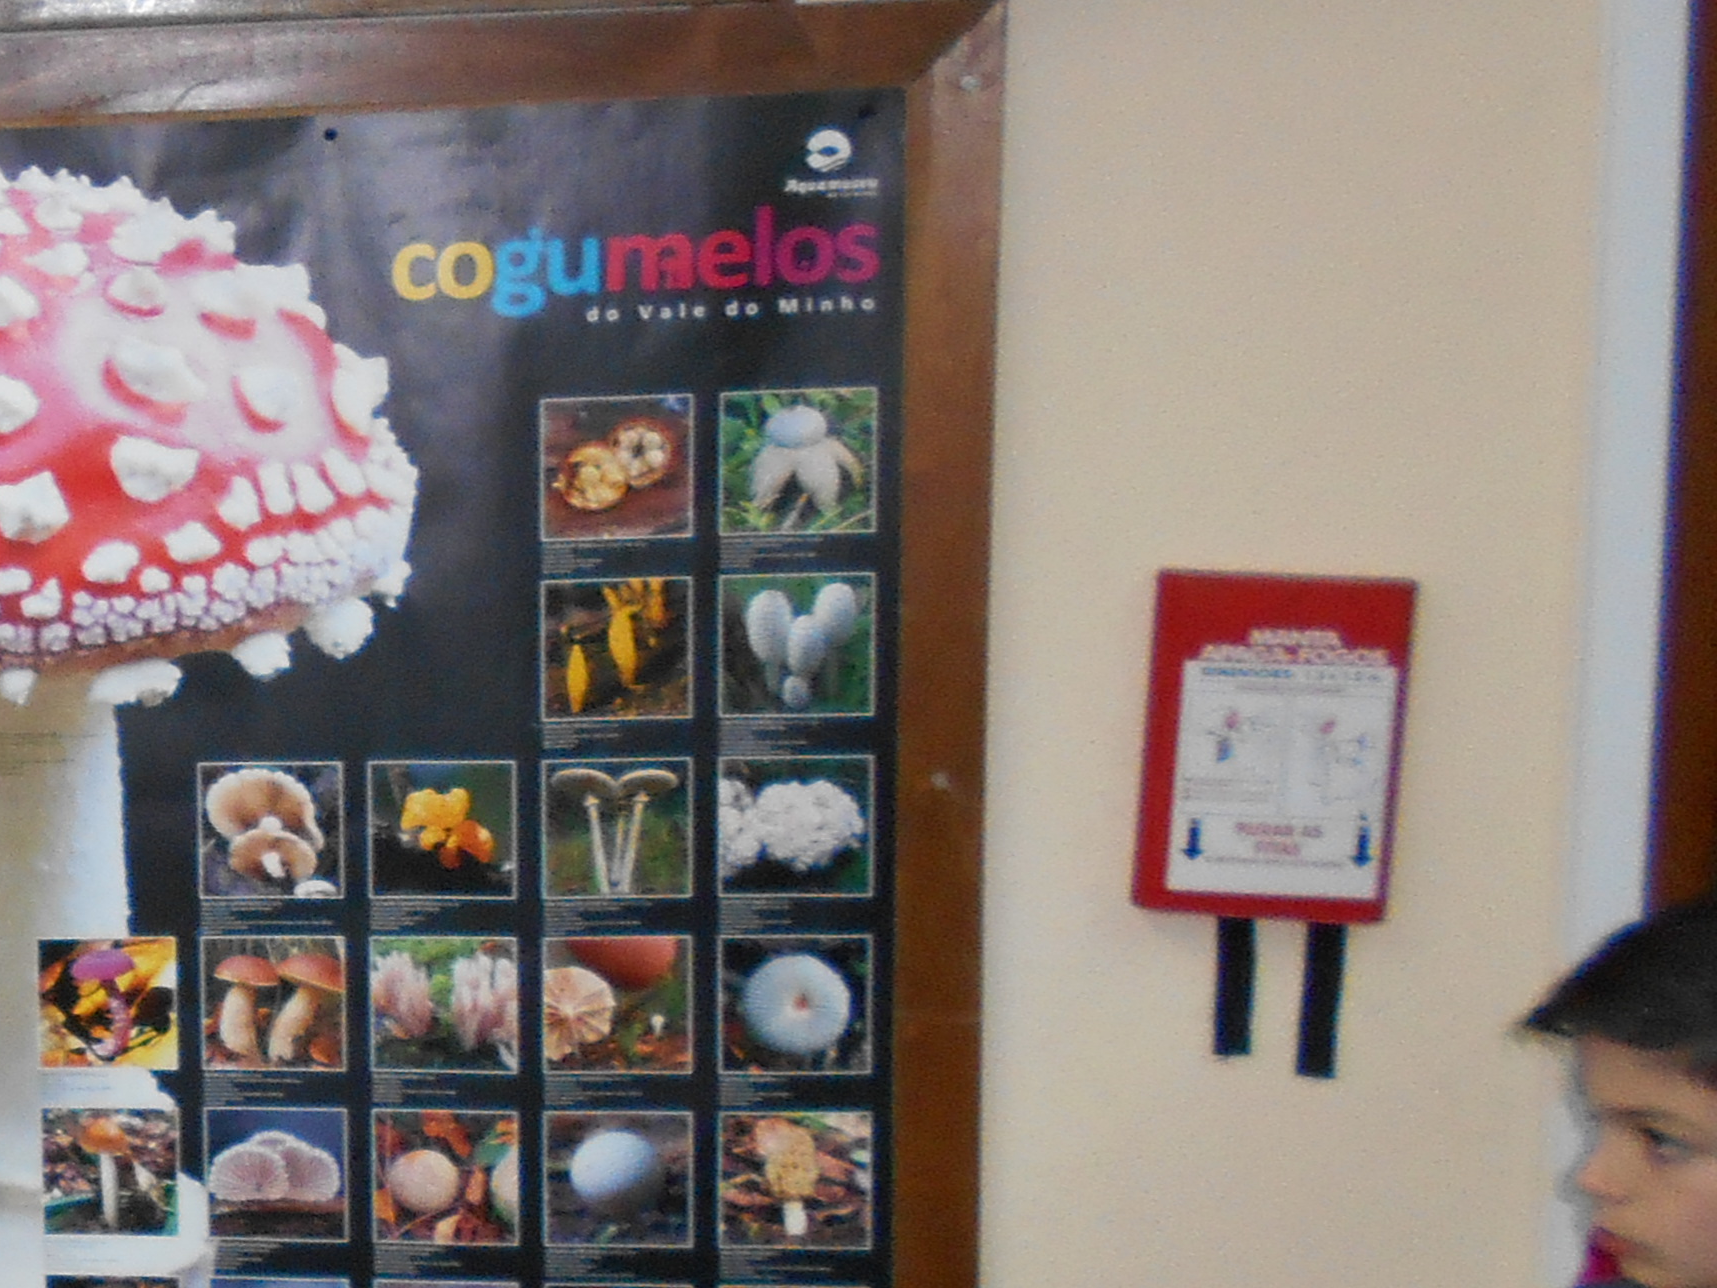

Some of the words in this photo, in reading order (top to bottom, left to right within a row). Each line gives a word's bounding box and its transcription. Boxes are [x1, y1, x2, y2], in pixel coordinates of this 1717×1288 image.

[392, 205, 881, 318] cogumelos
[586, 306, 619, 322] do
[638, 303, 706, 320] Vale
[725, 300, 758, 316] do
[778, 296, 875, 313] Minho
